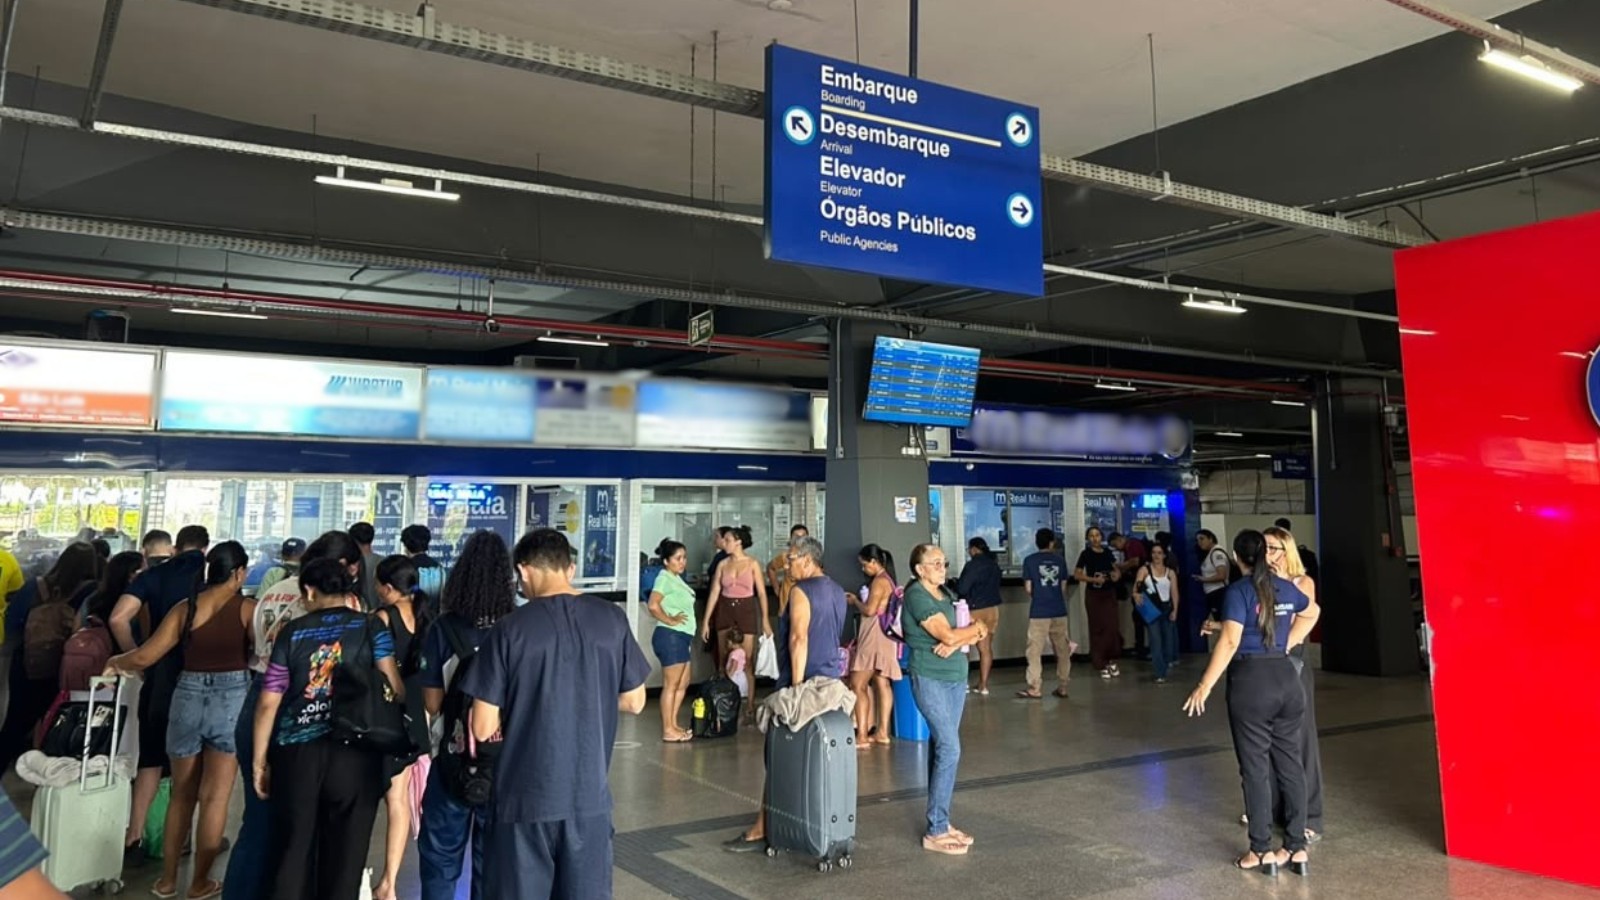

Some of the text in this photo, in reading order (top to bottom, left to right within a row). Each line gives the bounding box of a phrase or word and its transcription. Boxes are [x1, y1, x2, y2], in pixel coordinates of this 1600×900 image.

[821, 64, 918, 105] Embarque
[821, 89, 866, 111] Boarding
[820, 112, 950, 158] Desembarque
[820, 139, 854, 155] Arrival
[820, 156, 906, 188] Elevador
[820, 181, 863, 198] Elevator
[820, 196, 977, 241] Órgãos Públicos
[820, 230, 899, 253] Public Agencies
[1009, 494, 1027, 504] Real
